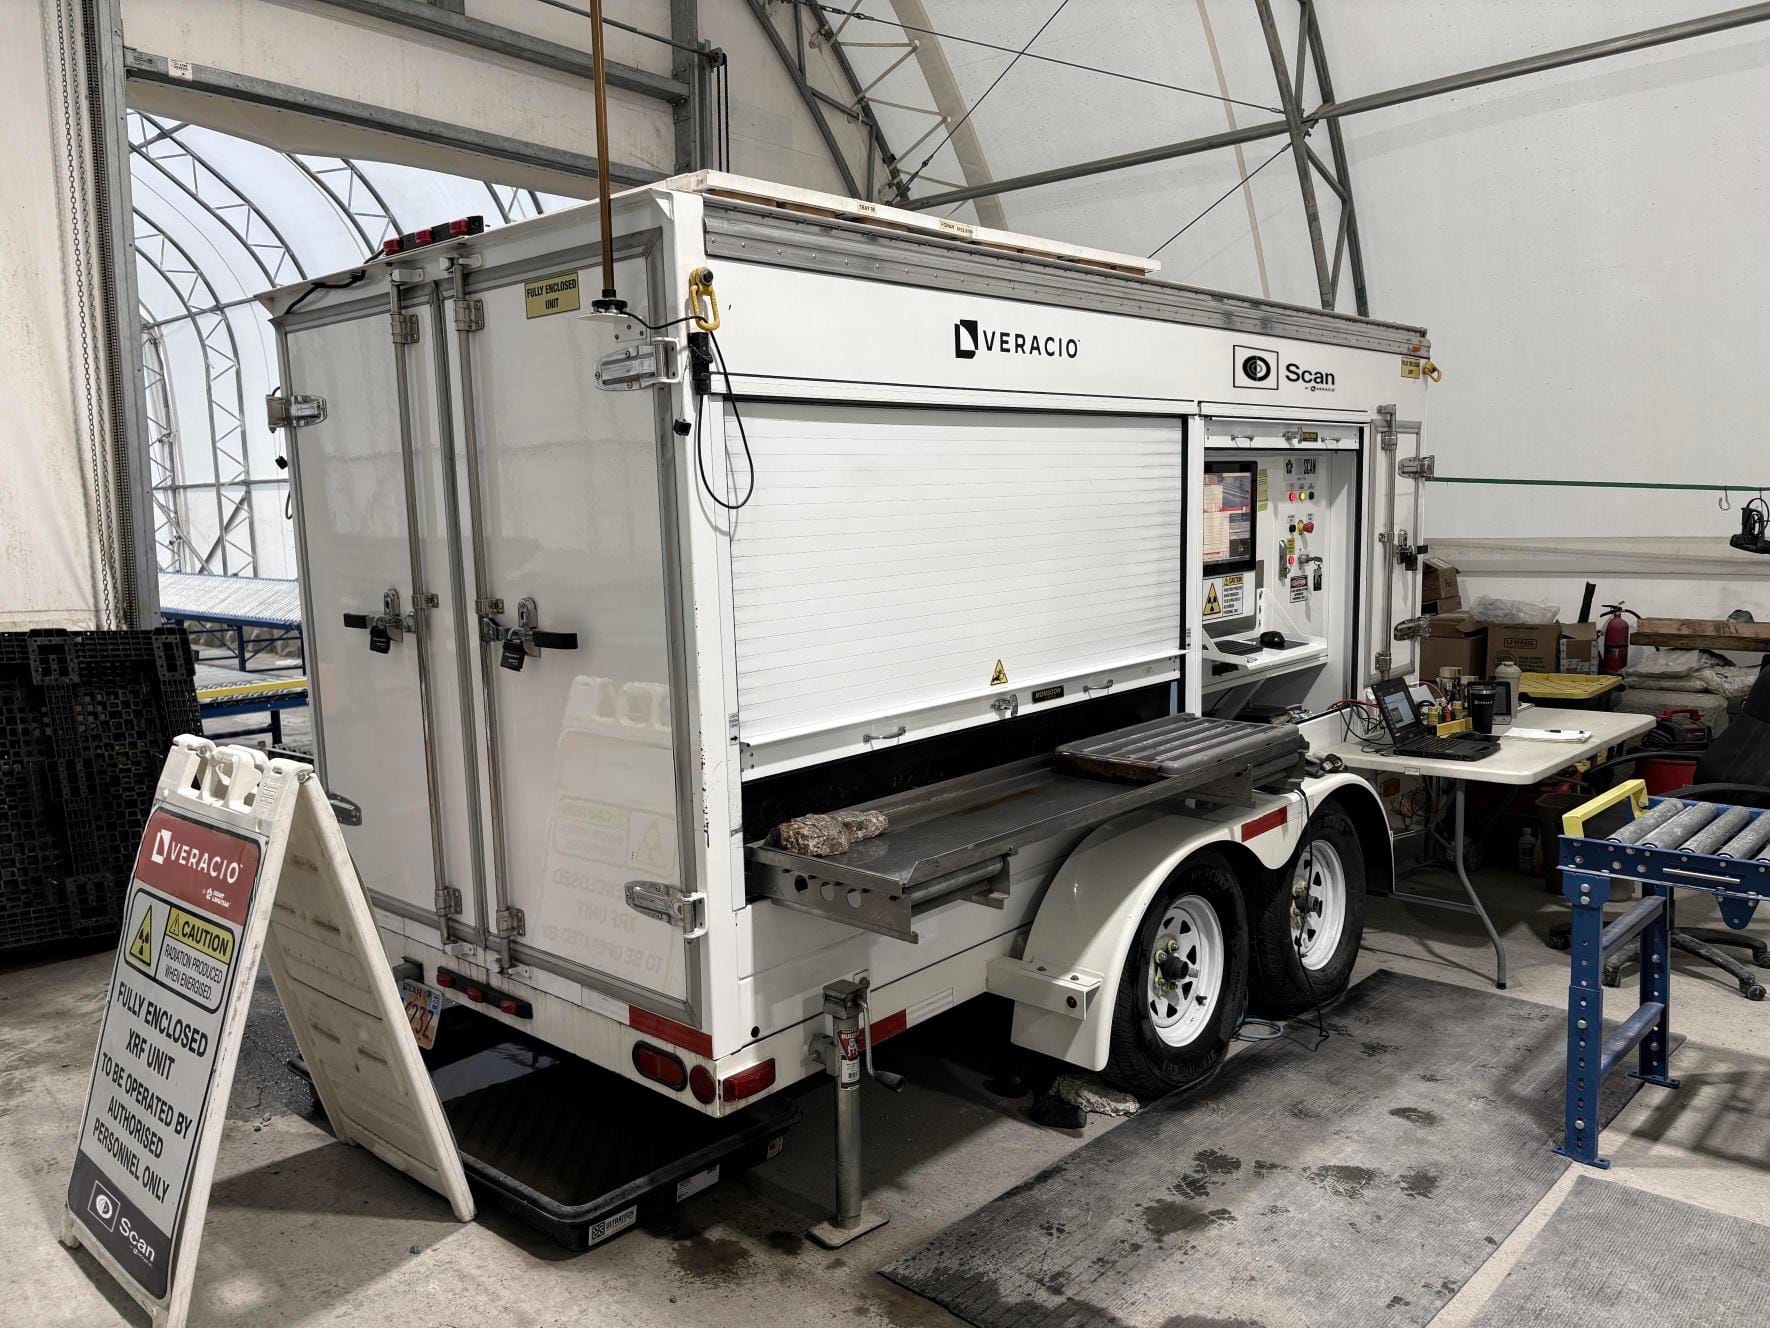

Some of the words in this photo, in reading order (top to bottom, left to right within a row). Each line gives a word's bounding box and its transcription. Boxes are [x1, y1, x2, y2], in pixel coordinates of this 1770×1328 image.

[527, 285, 544, 298] FULLY
[545, 279, 576, 294] ENCLOSED
[545, 298, 559, 309] UNIT
[982, 330, 1078, 358] VERACIO
[1285, 363, 1335, 385] Scan
[171, 841, 240, 883] VERACIO
[181, 921, 229, 956] CAUTION
[164, 944, 193, 969] RADIATION
[190, 956, 222, 984] PRODUCED
[165, 963, 182, 985] WHEN
[180, 972, 211, 1001] ENERGISED.
[117, 981, 145, 1018] FULLY
[144, 1000, 208, 1057] ENCLOSED
[125, 1027, 147, 1060] XRF
[146, 1043, 175, 1080] UNIT
[101, 1052, 112, 1077] TO
[111, 1060, 125, 1088] BE
[124, 1073, 174, 1127] OPERATED
[174, 1112, 192, 1139] BY
[107, 1096, 163, 1159] AUTHORISED
[92, 1117, 140, 1181] PERSONNEL
[142, 1165, 169, 1204] ONLY
[119, 1218, 155, 1261] Scan
